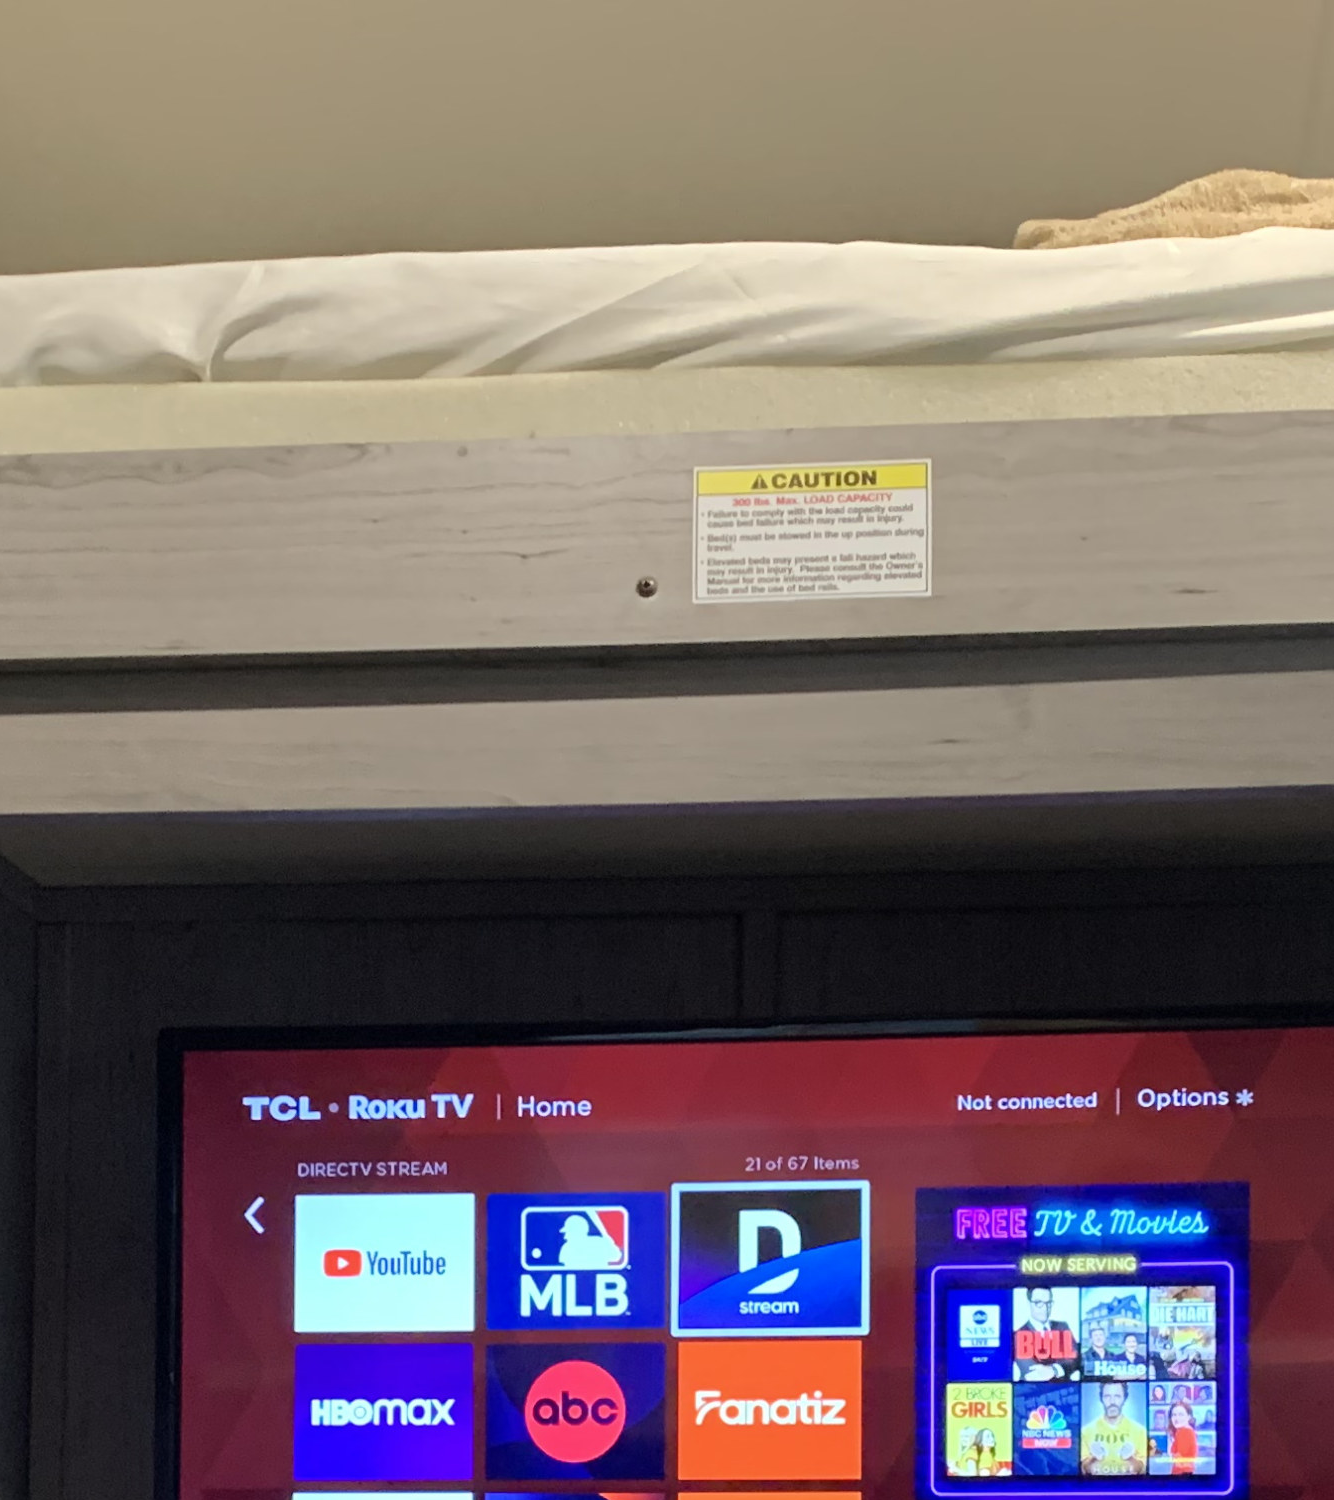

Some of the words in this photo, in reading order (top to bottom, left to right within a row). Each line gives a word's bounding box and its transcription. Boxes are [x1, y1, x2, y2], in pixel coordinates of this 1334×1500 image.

[771, 470, 877, 489] CAUTION
[804, 493, 835, 504] LOAD
[837, 492, 893, 503] CAPACITY
[707, 509, 738, 518] Failure
[740, 508, 749, 517] to
[752, 507, 784, 518] comply
[787, 506, 806, 515] with
[809, 506, 823, 515] the
[825, 505, 845, 514] load
[847, 504, 885, 517] capacity
[888, 503, 913, 512] could
[708, 520, 734, 528] cause
[736, 519, 754, 527] bed
[756, 518, 785, 527] failure
[787, 516, 814, 525] which
[816, 517, 835, 526] may
[838, 514, 863, 524] result
[866, 514, 875, 522] in
[877, 513, 904, 523] injury.
[740, 532, 762, 541] must
[765, 531, 776, 541] be
[779, 530, 811, 540] stowed
[814, 530, 822, 539] in
[825, 530, 839, 539] the
[841, 531, 853, 540] up
[856, 528, 893, 540] position
[895, 527, 925, 538] during
[707, 557, 746, 566] Elevated
[748, 556, 771, 566] beds
[773, 556, 792, 566] may
[795, 555, 829, 565] present
[856, 552, 887, 561] hazard
[889, 551, 917, 560] which
[707, 569, 725, 577] may
[728, 566, 754, 575] result
[756, 566, 765, 575] in
[800, 564, 830, 573] Please
[833, 562, 866, 572] consult
[869, 562, 884, 571] the
[886, 560, 924, 570] Owner's
[708, 577, 740, 586] Manual
[757, 576, 781, 584] more
[783, 573, 835, 584] information
[837, 572, 881, 583] regarding
[884, 570, 922, 580] elevated
[707, 587, 729, 596] beds
[731, 585, 748, 595] and
[751, 584, 766, 594] the
[768, 585, 784, 593] use
[787, 583, 796, 593] of
[799, 583, 815, 592] bed
[243, 1096, 320, 1121] TCL
[348, 1094, 426, 1120] Roku
[430, 1094, 474, 1119] TV
[517, 1095, 592, 1118] Home
[957, 1095, 992, 1111] Not
[998, 1092, 1097, 1110] connected
[1137, 1088, 1229, 1109] Options
[297, 1161, 373, 1178] DIRECTV
[376, 1160, 448, 1177] STREAM
[745, 1158, 761, 1172] 21
[766, 1157, 783, 1172] of
[787, 1157, 808, 1171] 67
[813, 1155, 860, 1171] Items
[955, 1207, 1028, 1239] FREE
[1033, 1209, 1076, 1237] TV
[1079, 1210, 1103, 1236] &
[1109, 1208, 1209, 1236] Movies
[367, 1250, 447, 1277] YouTube
[1021, 1257, 1062, 1273] NOW
[1067, 1255, 1137, 1273] SERVING
[520, 1275, 629, 1316] MLB
[739, 1300, 800, 1314] stream
[1152, 1304, 1174, 1323] DIE
[1175, 1304, 1214, 1323] HART
[965, 1327, 995, 1335] NEWS
[1015, 1330, 1077, 1360] BULL
[1094, 1360, 1147, 1376] House
[953, 1387, 962, 1400] 2
[966, 1386, 1006, 1400] BROKE
[532, 1391, 618, 1426] abc
[695, 1390, 847, 1425] Fanatiz
[951, 1401, 1008, 1419] GIRLS
[1022, 1429, 1042, 1438] NBC
[1042, 1429, 1071, 1438] NEWS
